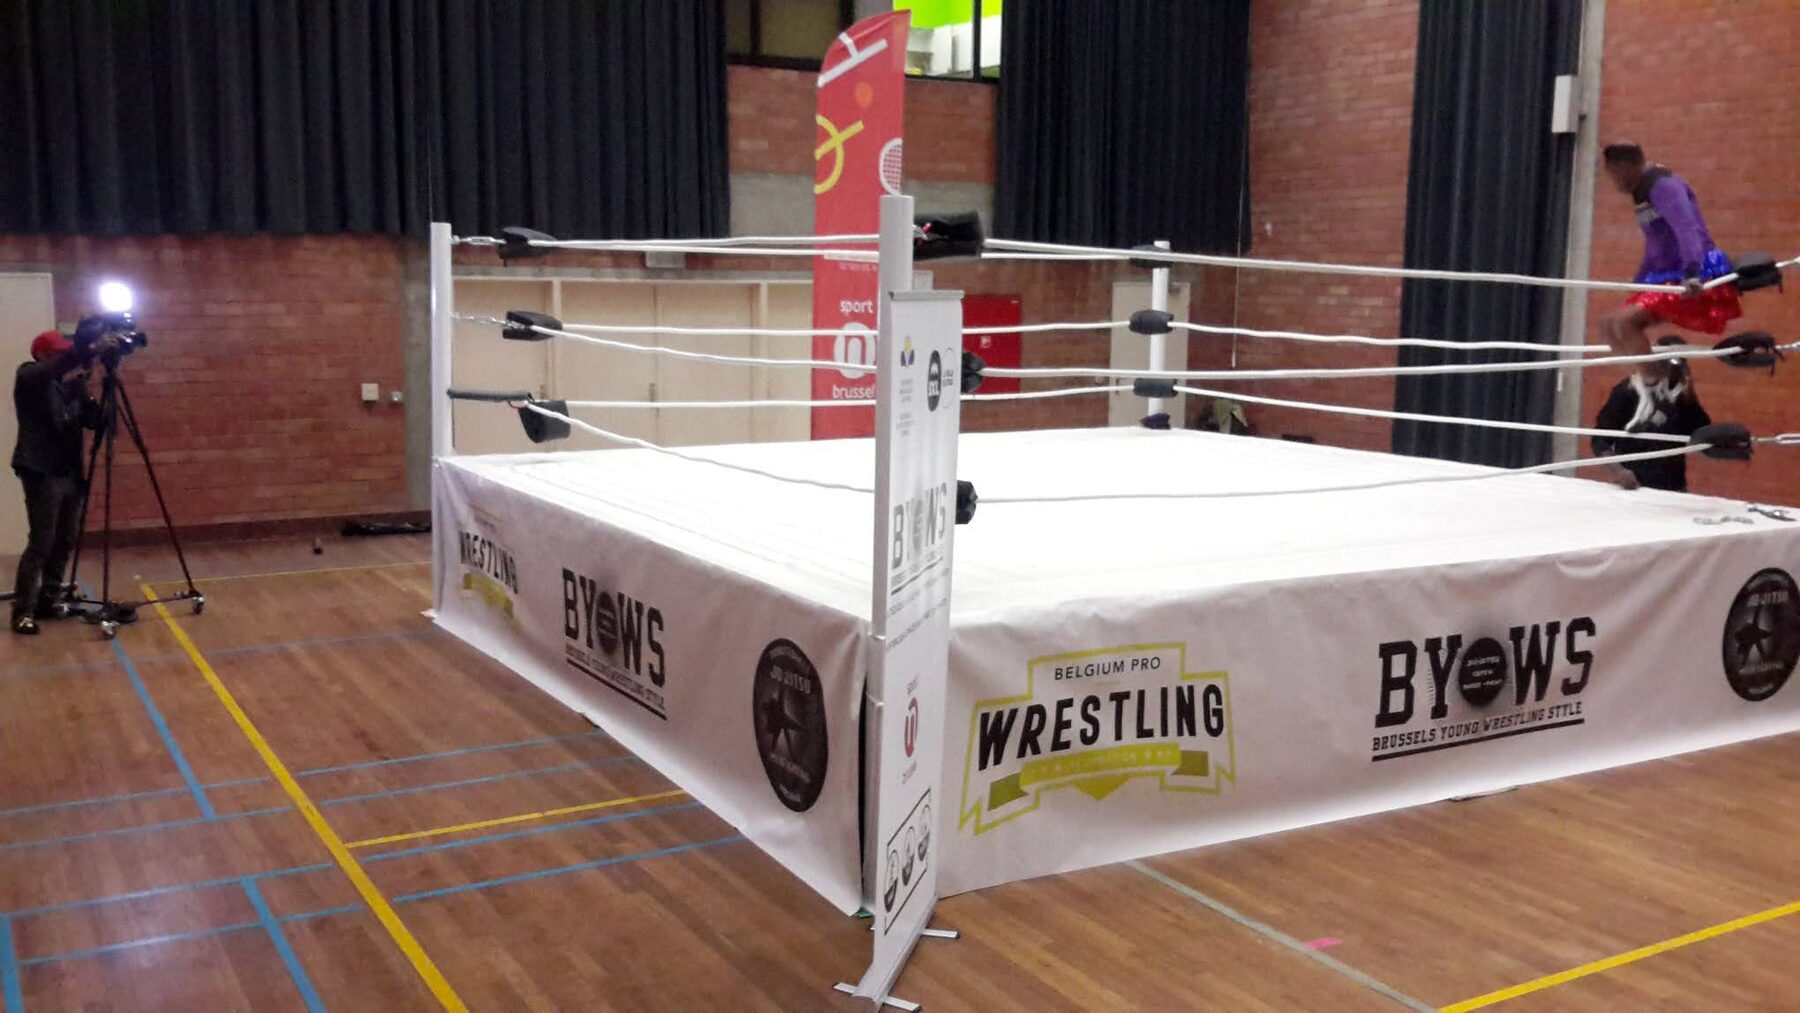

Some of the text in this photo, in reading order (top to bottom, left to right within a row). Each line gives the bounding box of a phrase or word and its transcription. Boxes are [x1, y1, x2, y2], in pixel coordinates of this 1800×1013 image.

[840, 300, 874, 316] sport
[1054, 656, 1161, 680] BELGIUM PRO
[1375, 617, 1596, 728] BYOWS
[978, 684, 1225, 771] WRESTLING
[1372, 702, 1583, 751] BRUSSELS YOUNG WRESTLING STYLE
